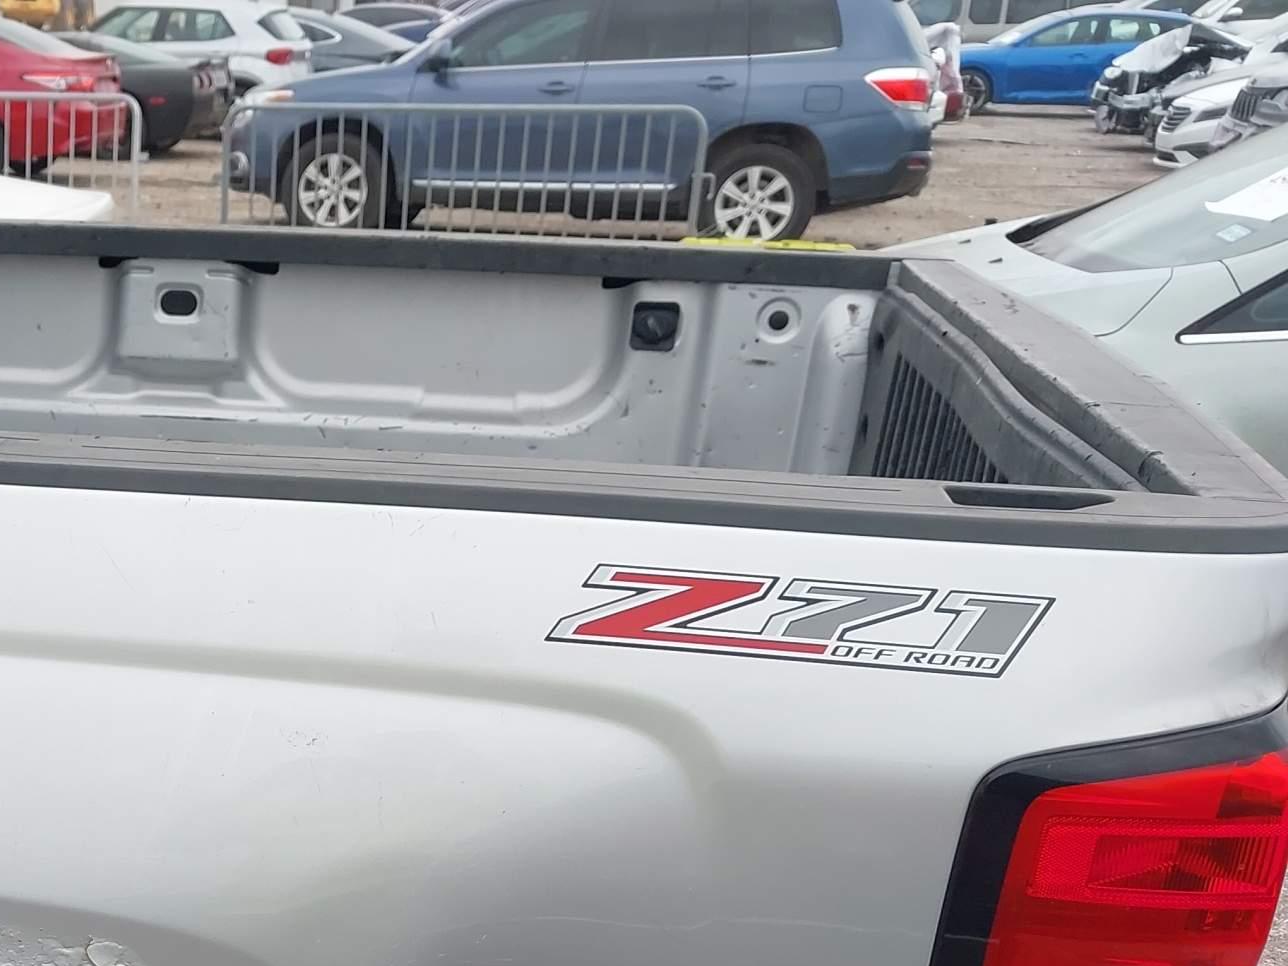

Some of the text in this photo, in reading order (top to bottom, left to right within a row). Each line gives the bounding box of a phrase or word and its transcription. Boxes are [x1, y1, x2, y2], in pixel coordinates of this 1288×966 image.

[544, 563, 1056, 678] Z71
[830, 645, 1000, 670] OFF ROAD
